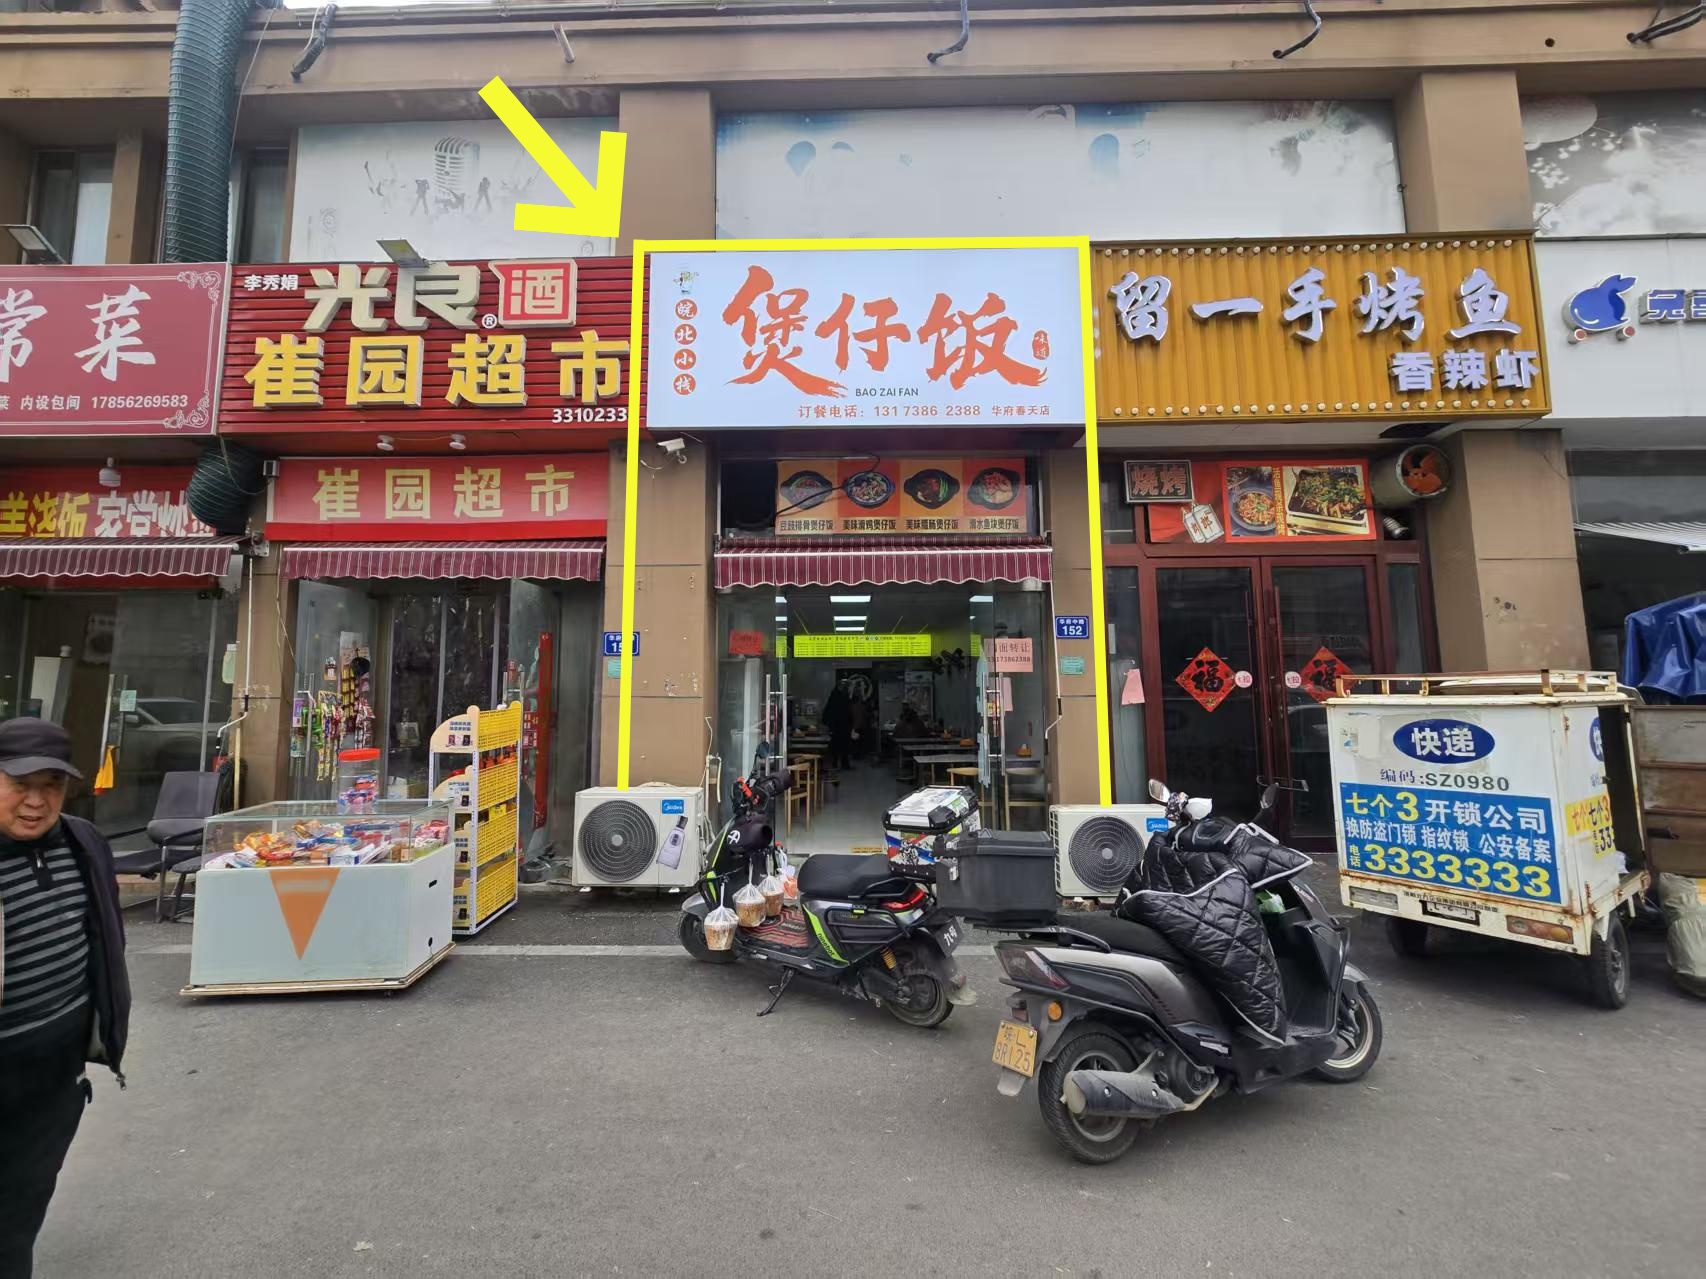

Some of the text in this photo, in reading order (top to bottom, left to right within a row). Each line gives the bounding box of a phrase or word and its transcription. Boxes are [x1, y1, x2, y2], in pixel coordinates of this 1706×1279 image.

[244, 274, 298, 292] 李秀娟
[1107, 265, 1522, 343] 留一手烤鱼
[722, 264, 1048, 399] 煲仔饭
[244, 331, 630, 408] 崔园超市
[1390, 350, 1538, 391] 香辣虾
[20, 395, 81, 411] 内设包间
[91, 394, 188, 410] 17856269583
[855, 387, 919, 397] BAO ZAI FAN
[552, 408, 627, 424] 3310233
[873, 406, 898, 418] 131
[903, 406, 938, 417] 7386
[946, 406, 981, 417] 2388
[991, 405, 1051, 417] 华府春天店
[313, 464, 575, 521] 崔园超市
[1062, 625, 1083, 635] 152
[1410, 727, 1476, 757] 快递
[1345, 816, 1552, 864] 换防盗门锁 指纹锁 公安备案
[1349, 843, 1552, 897] 电话 3333333
[817, 933, 836, 957] ninebot
